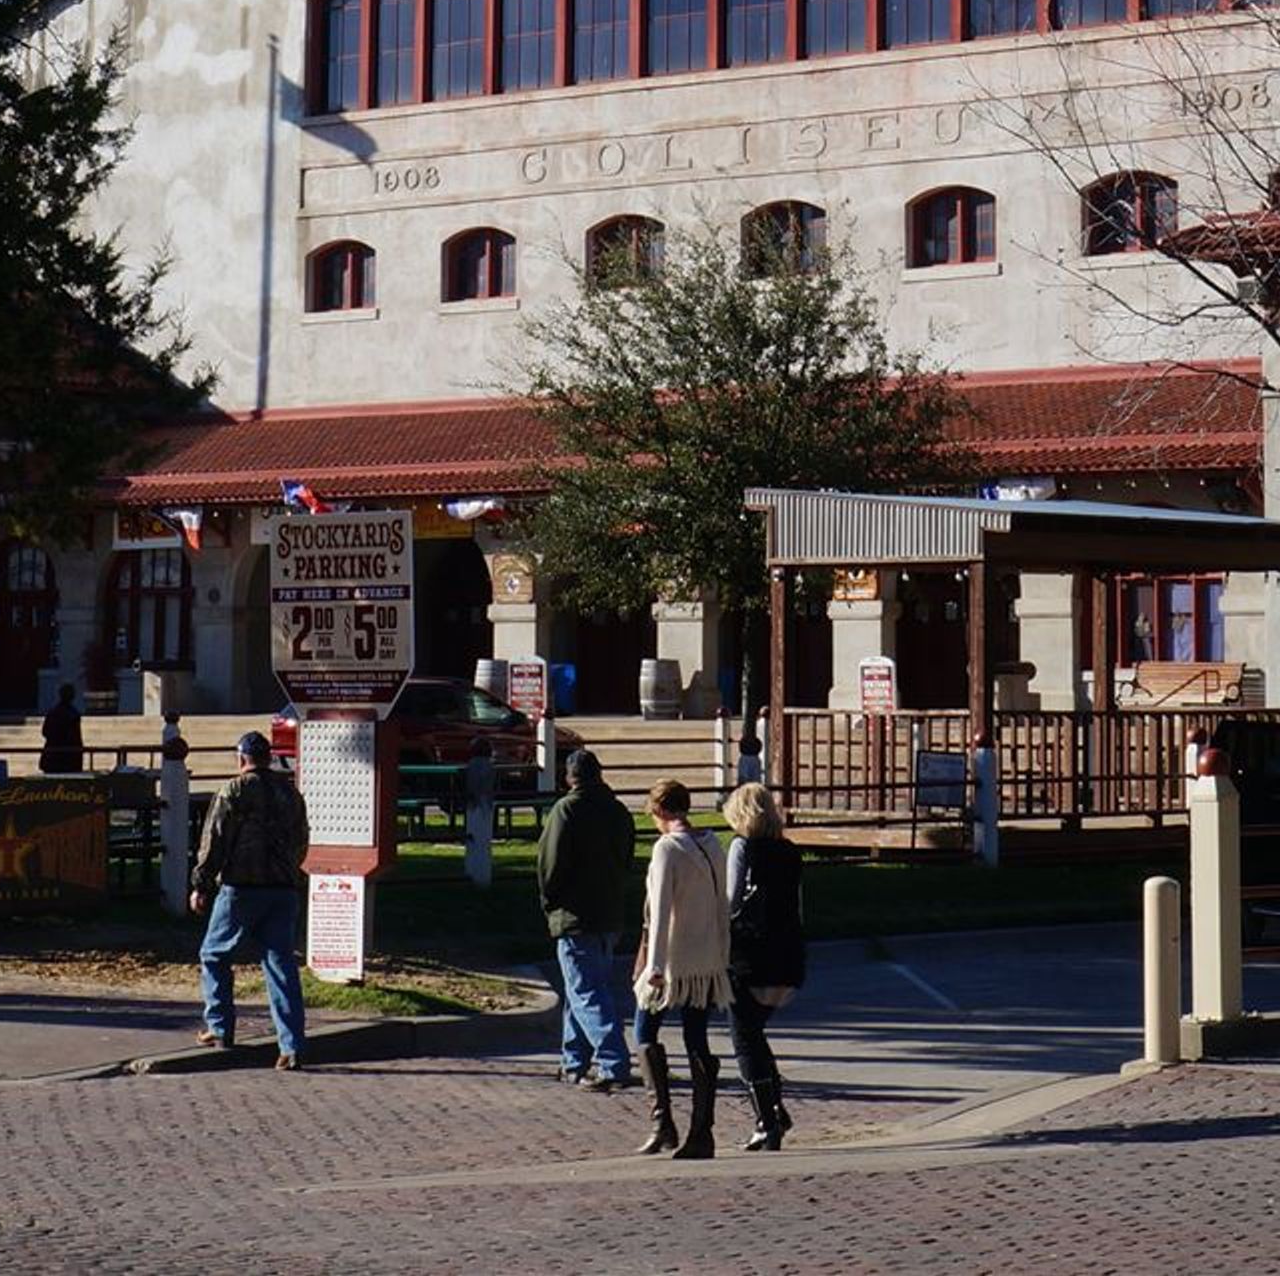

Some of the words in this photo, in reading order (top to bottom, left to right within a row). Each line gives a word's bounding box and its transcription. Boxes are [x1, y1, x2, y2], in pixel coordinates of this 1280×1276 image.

[521, 90, 1084, 184] COLISEUM
[372, 166, 441, 195] 1908
[277, 519, 405, 559] STOCKYARDS
[294, 554, 388, 581] PARKING
[278, 589, 298, 600] PAY
[302, 588, 332, 600] HERE
[336, 588, 350, 599] IN
[353, 587, 405, 599] ADVANCE
